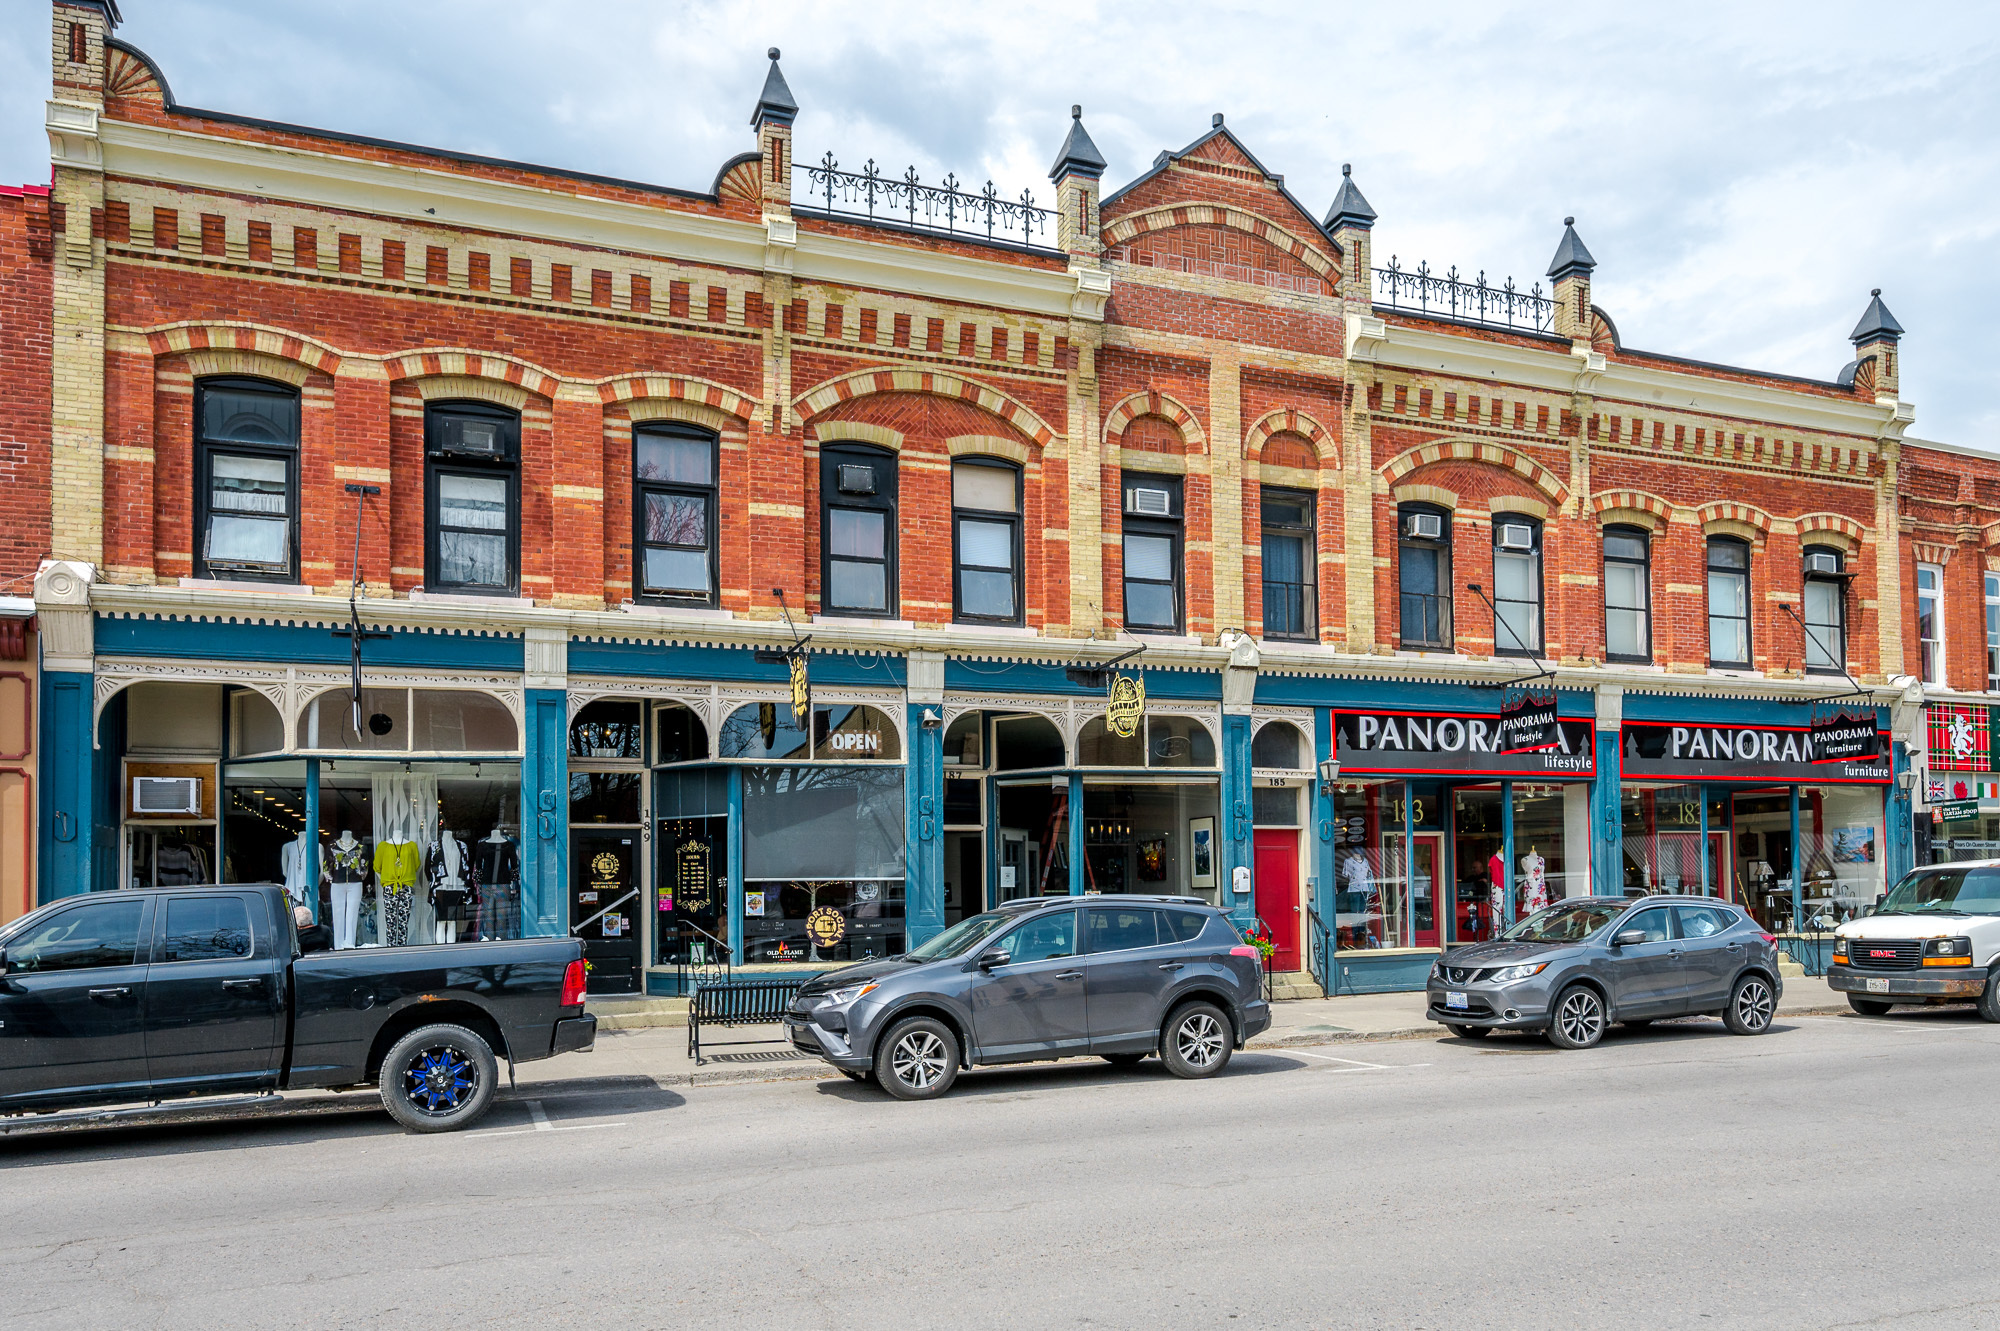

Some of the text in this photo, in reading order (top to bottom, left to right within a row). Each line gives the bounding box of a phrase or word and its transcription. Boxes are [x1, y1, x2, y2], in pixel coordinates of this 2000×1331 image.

[1503, 712, 1554, 732] PANORAMA
[832, 734, 877, 750] OPEN
[1359, 716, 1571, 755] PANORA
[1514, 731, 1543, 744] lifestyle
[1814, 726, 1874, 743] PANORAMA
[1826, 742, 1862, 754] furniture
[1544, 755, 1592, 771] lifestyle
[1844, 763, 1889, 777] furniture
[943, 771, 962, 780] 187
[1269, 778, 1286, 787] 185
[643, 809, 651, 842] 189
[805, 907, 824, 930] PORT
[826, 907, 846, 939] SOCIAL
[1870, 950, 1896, 958] GMC
